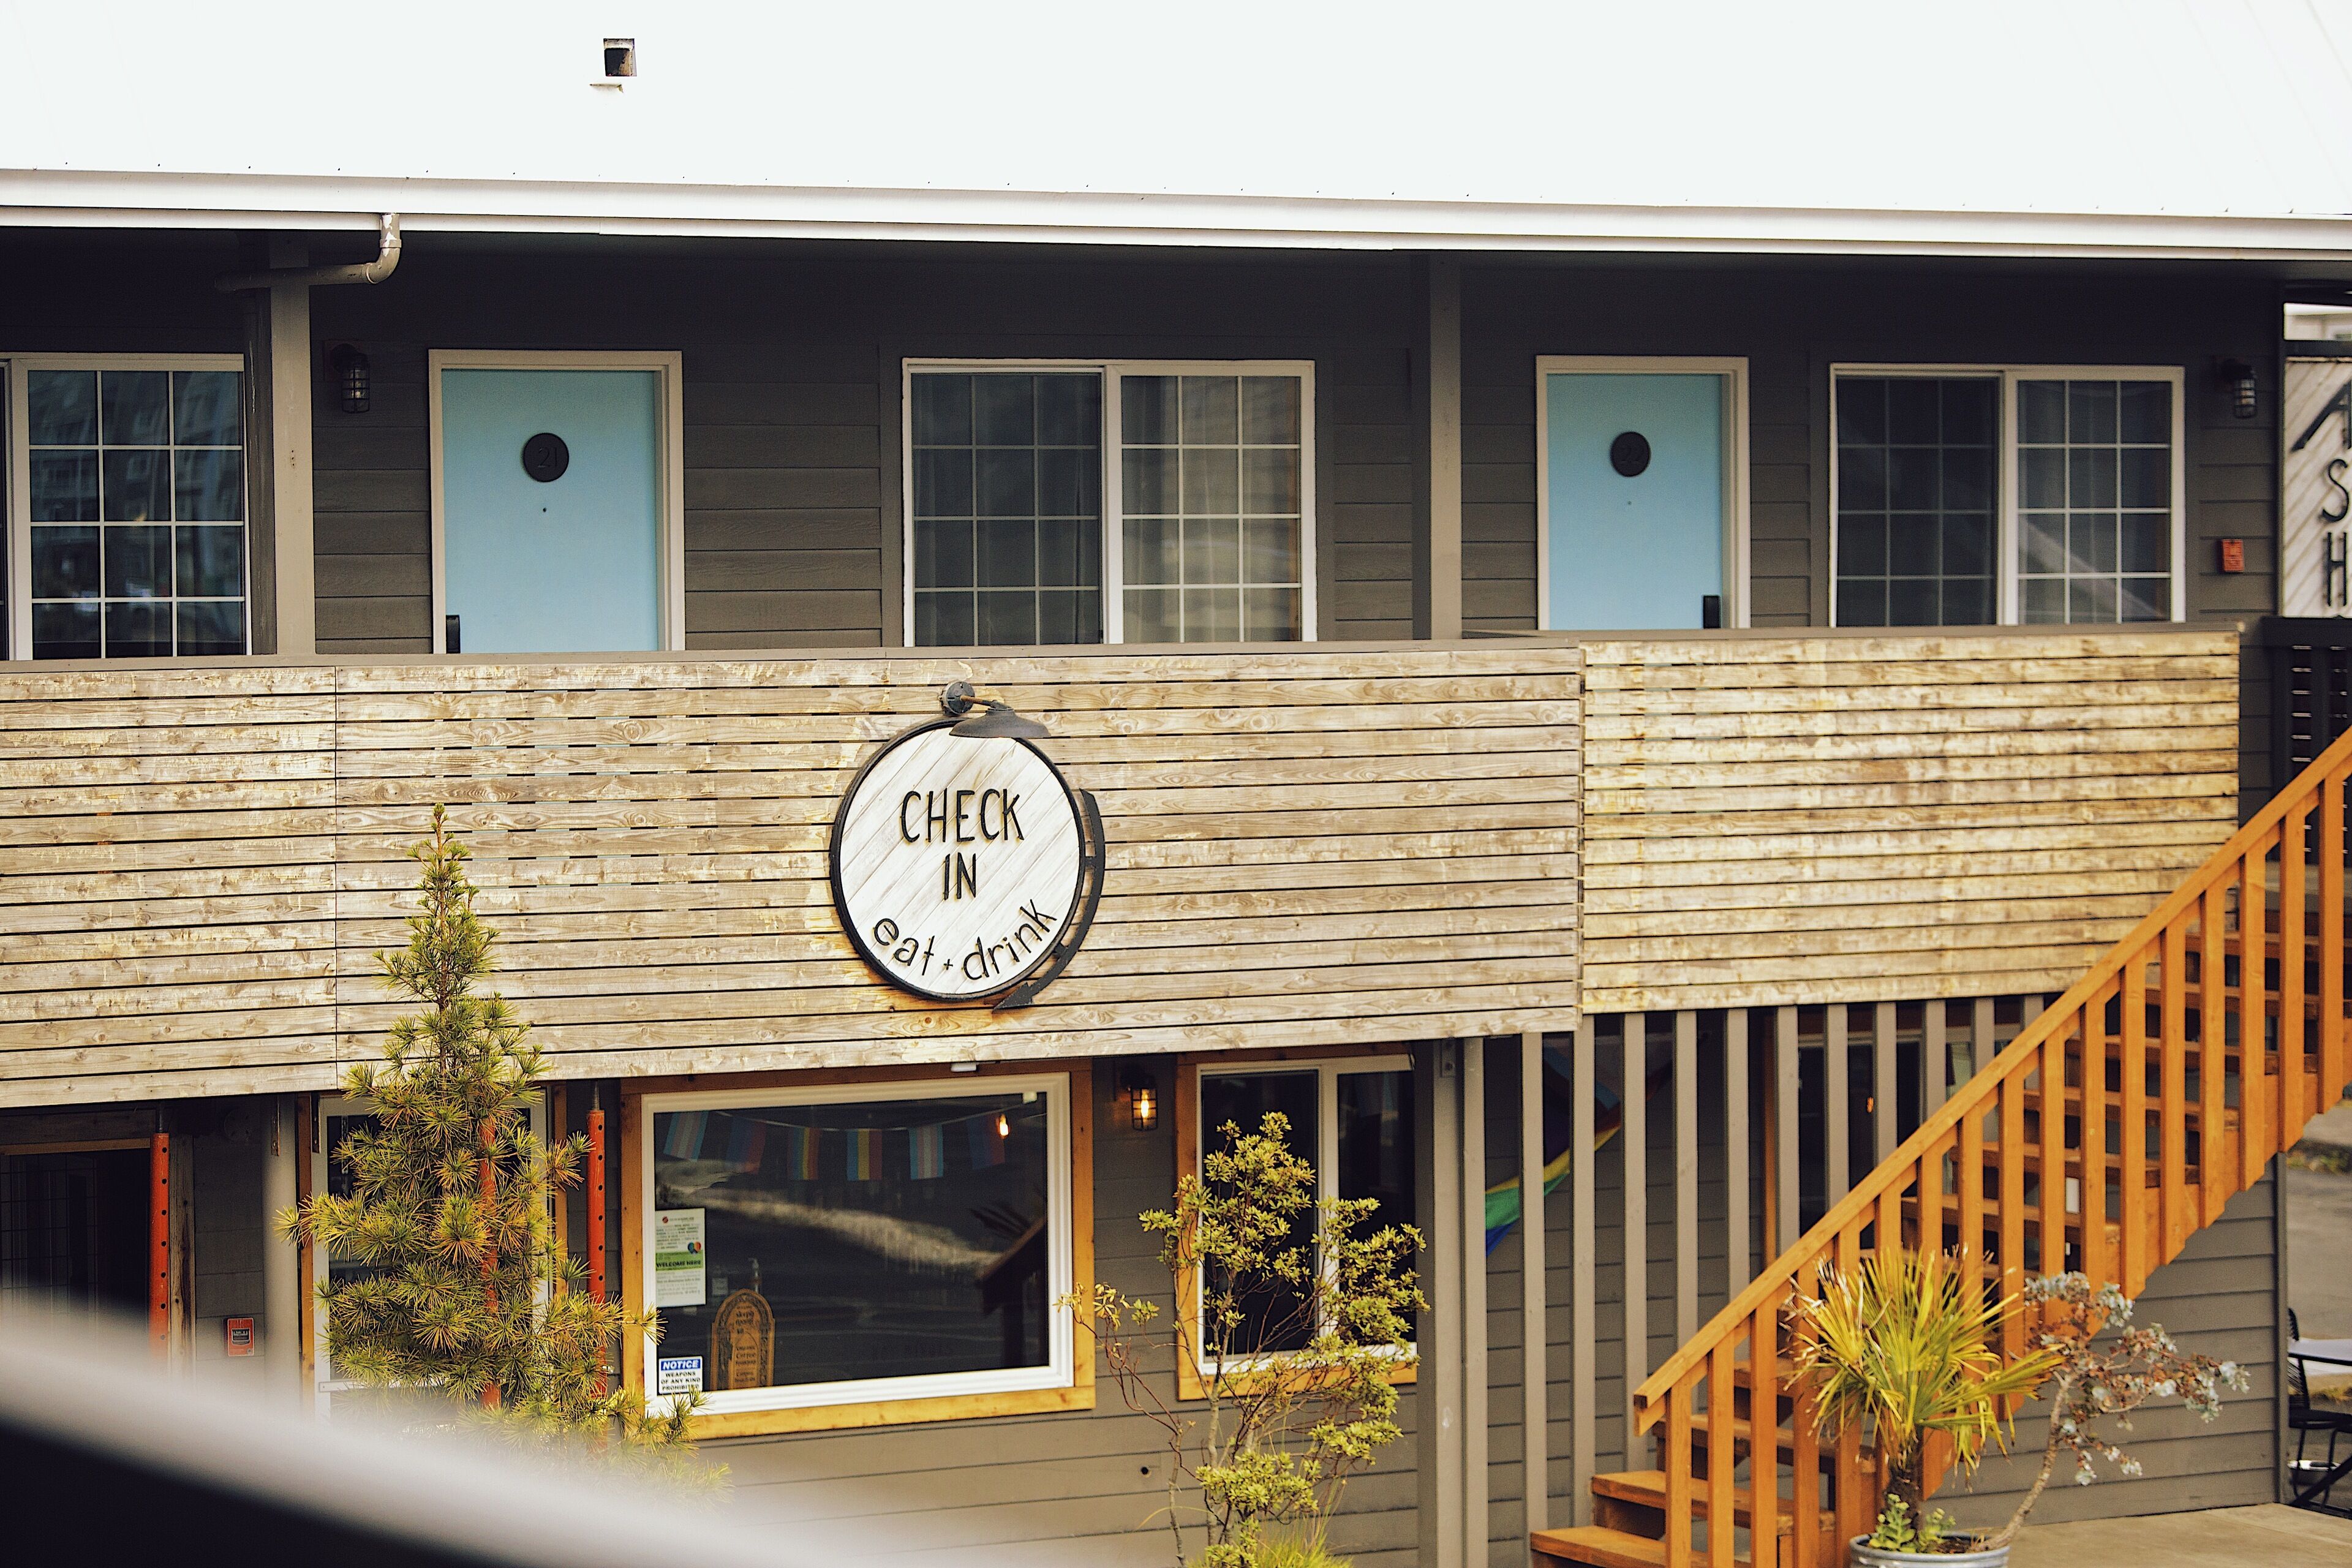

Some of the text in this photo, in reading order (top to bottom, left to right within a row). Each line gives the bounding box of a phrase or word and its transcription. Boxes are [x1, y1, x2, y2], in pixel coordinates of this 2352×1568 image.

[537, 447, 557, 469] 21
[900, 788, 1024, 843] CHECK
[944, 852, 977, 900] IN
[873, 898, 1057, 981] eat + drink
[663, 1360, 699, 1370] NOTICE
